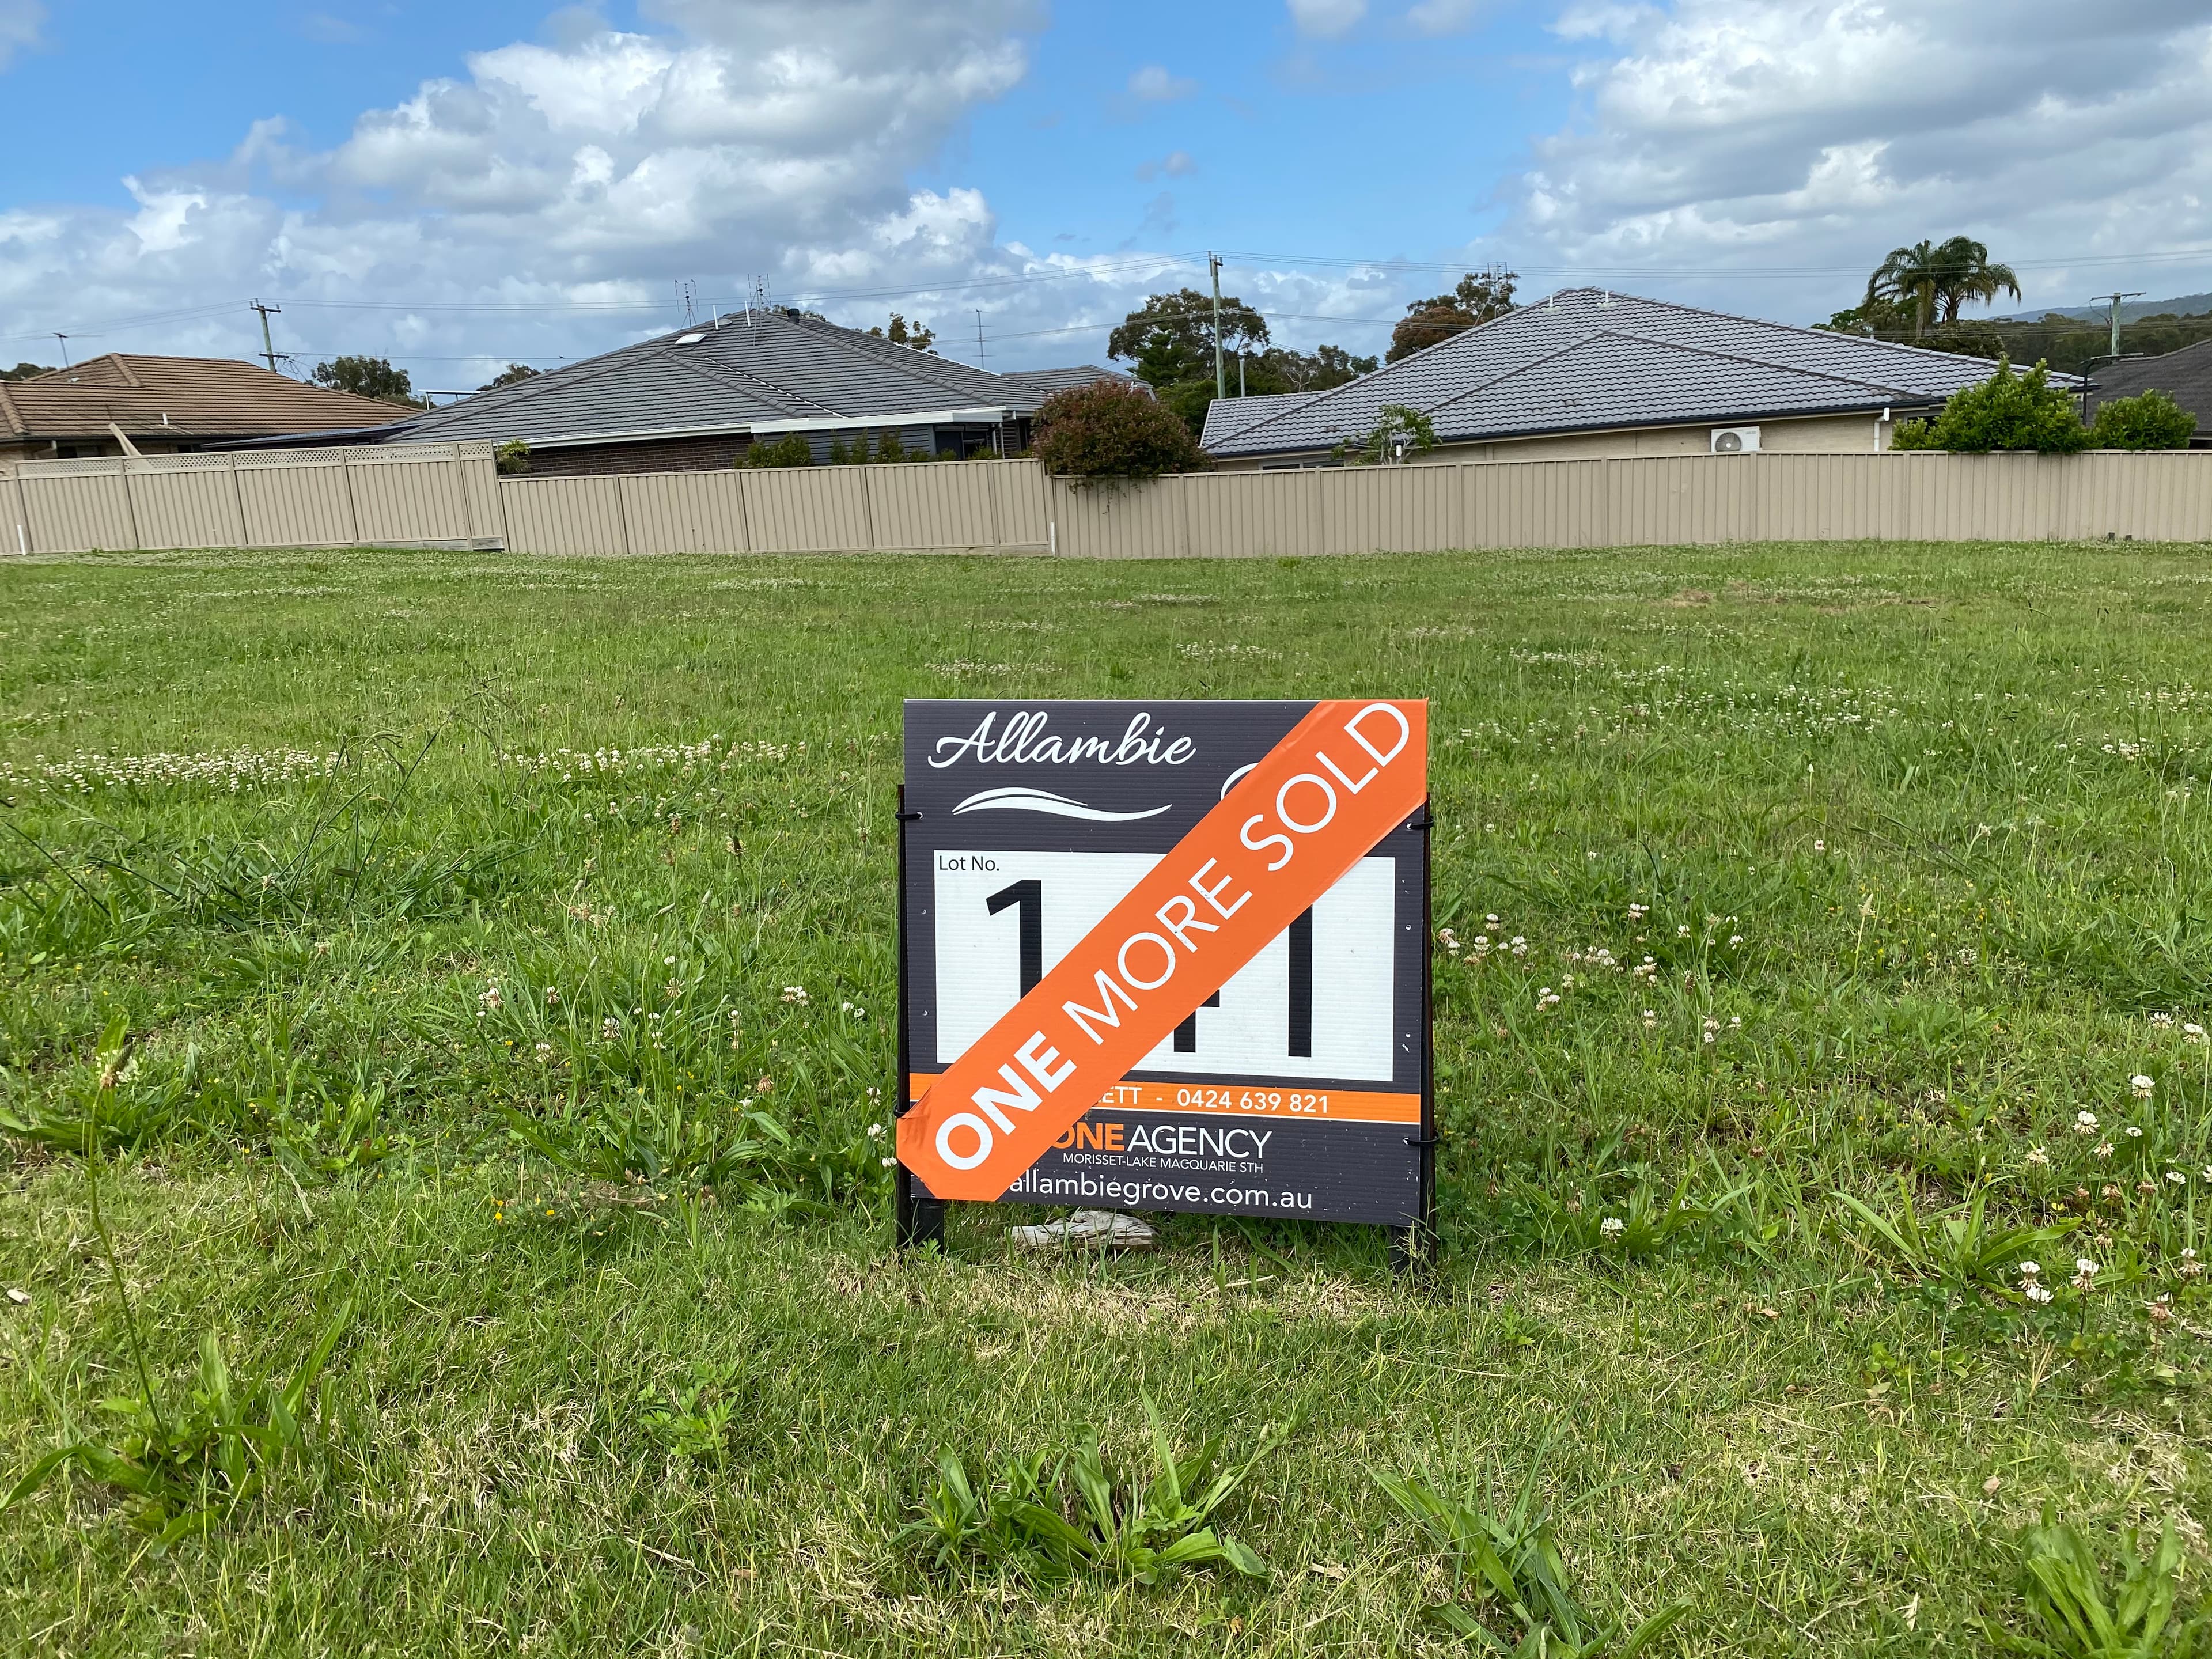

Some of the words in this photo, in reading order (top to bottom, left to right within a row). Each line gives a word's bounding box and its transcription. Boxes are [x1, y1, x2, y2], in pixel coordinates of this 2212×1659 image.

[927, 710, 1197, 768] Allambie
[939, 855, 967, 871] Lot
[971, 855, 1000, 872] No.
[934, 1029, 1078, 1171] ONE
[1060, 856, 1253, 1046] MORE
[1239, 702, 1410, 872] SOLD
[986, 879, 1313, 1058] 11
[1097, 1085, 1143, 1105] ETT
[1176, 1088, 1233, 1109] 0424
[1239, 1091, 1282, 1111] 639
[1289, 1093, 1327, 1114] 821
[1062, 1152, 1157, 1168] MORISSET-LAKE
[1160, 1157, 1237, 1172] MACQUARIE
[1239, 1162, 1264, 1174] STH
